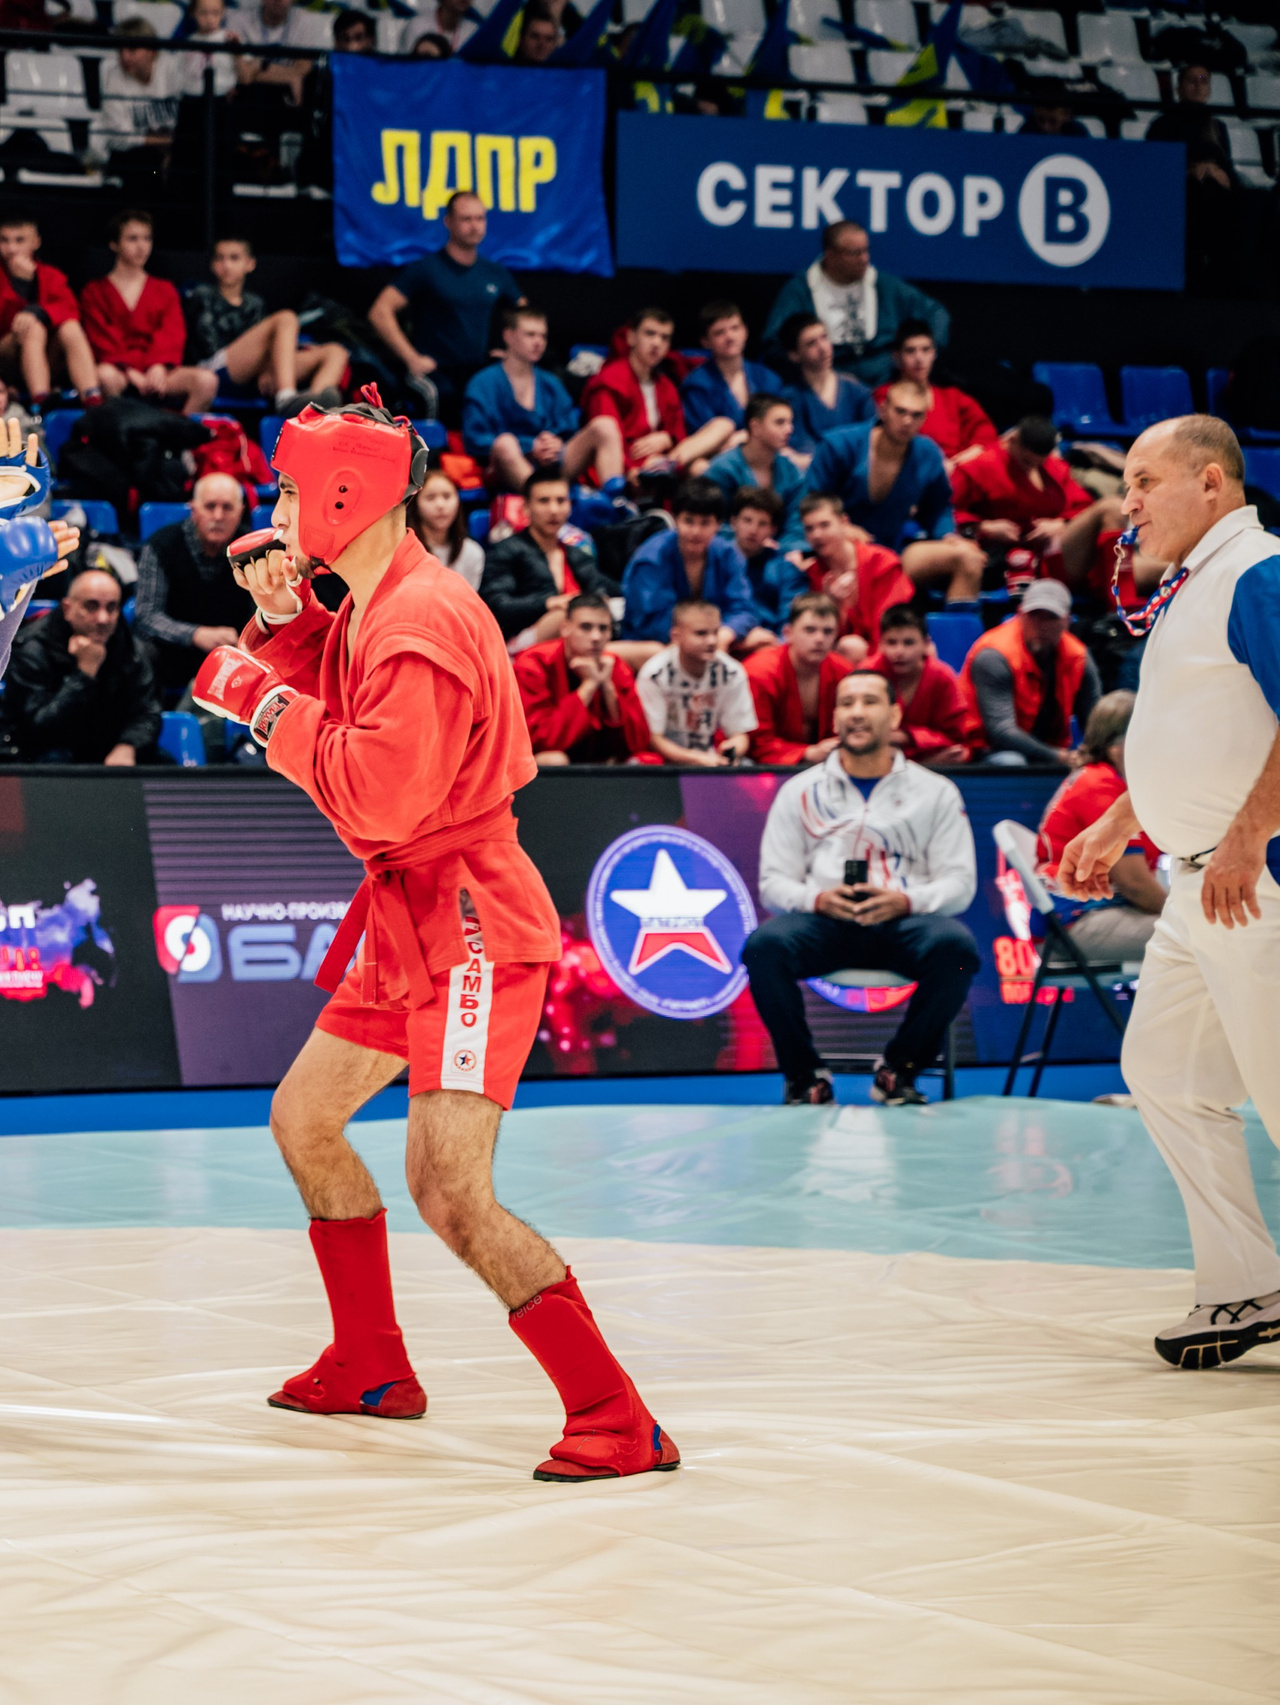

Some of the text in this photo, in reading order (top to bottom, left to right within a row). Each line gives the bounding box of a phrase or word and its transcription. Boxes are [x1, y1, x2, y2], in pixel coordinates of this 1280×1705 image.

[371, 129, 557, 220] ЛДПР
[696, 161, 1004, 237] СЕКТОР
[221, 901, 354, 921] НАУЧНО-ПРОИЗВ
[459, 941, 483, 1028] САМБО
